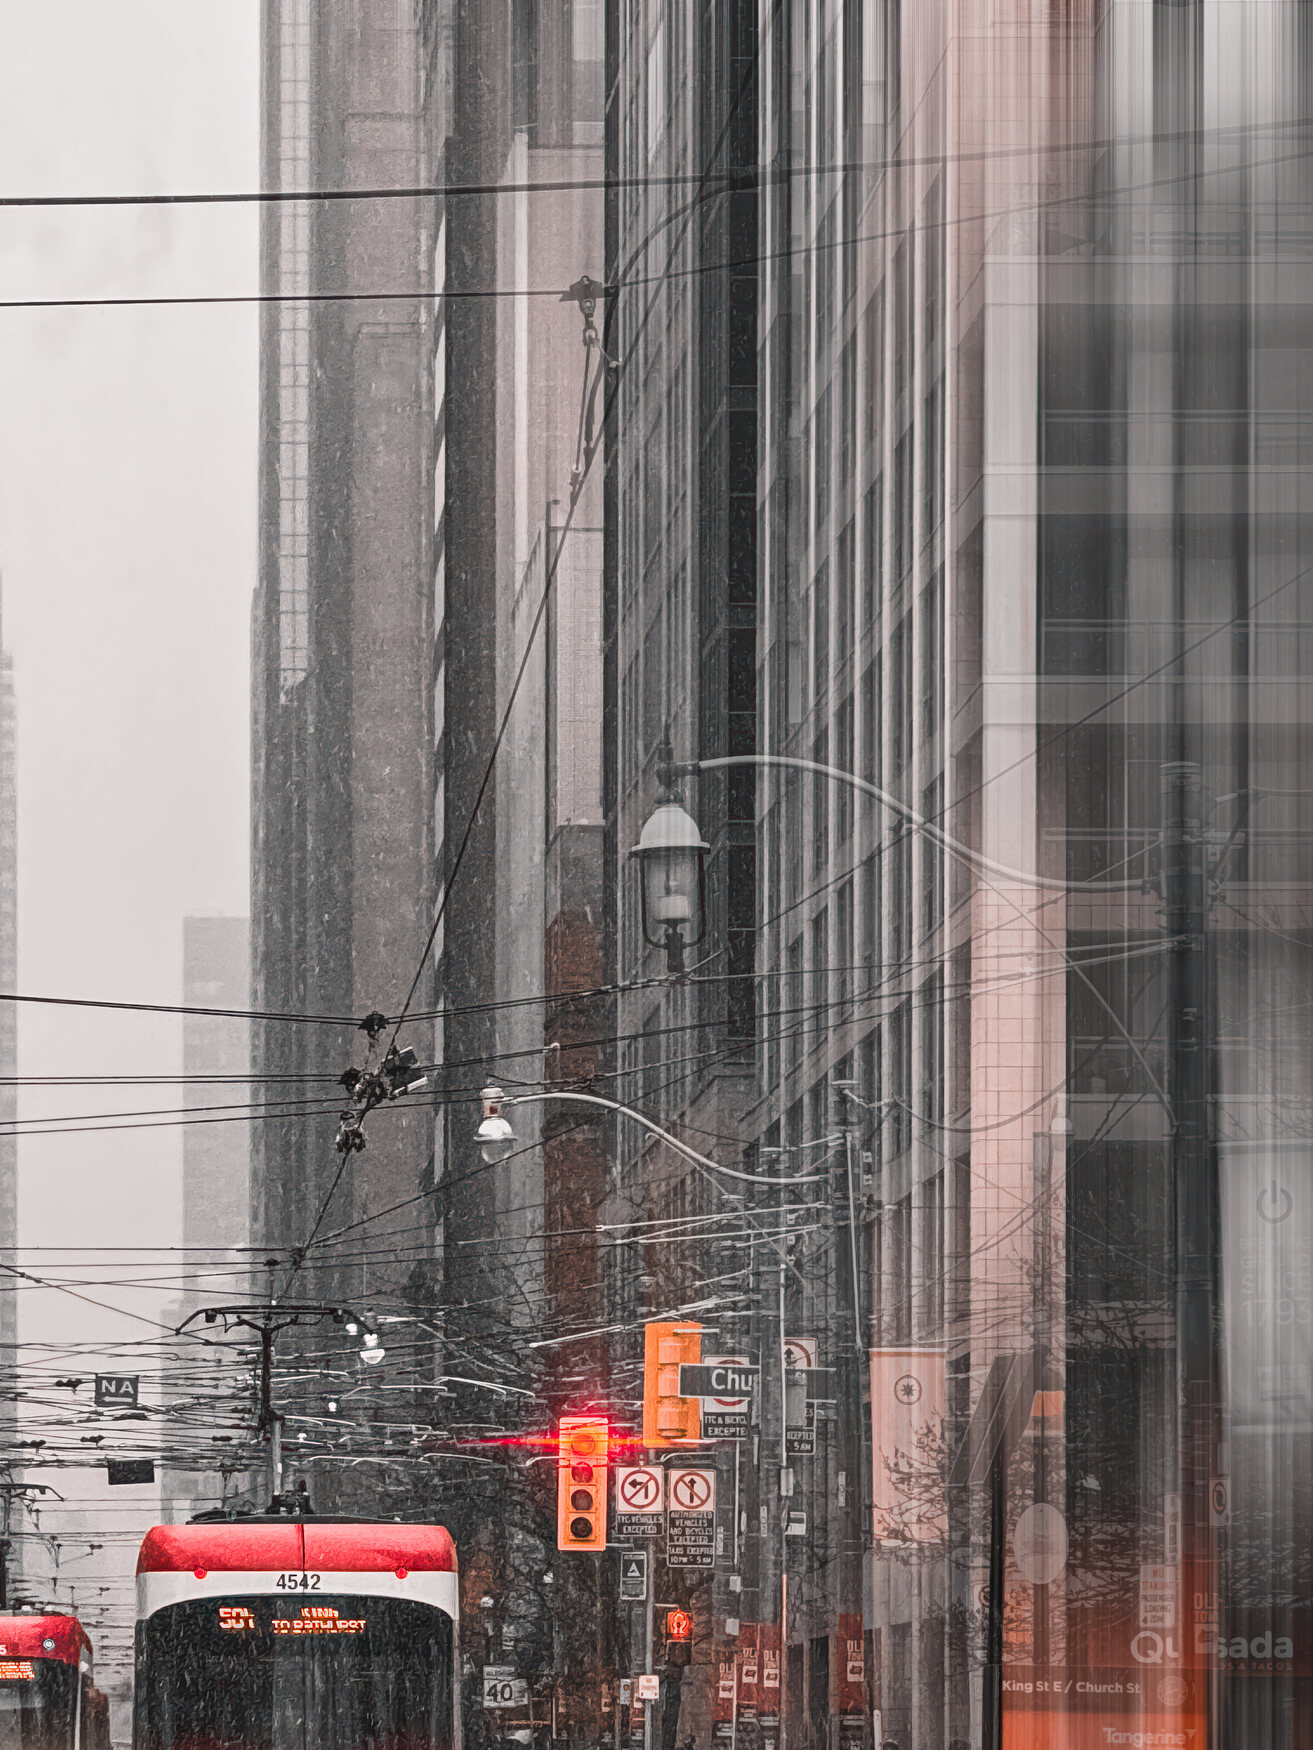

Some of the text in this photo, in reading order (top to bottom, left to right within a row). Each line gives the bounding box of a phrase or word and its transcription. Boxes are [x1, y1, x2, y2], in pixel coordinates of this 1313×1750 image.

[101, 1379, 135, 1394] NA
[707, 1427, 747, 1436] EXCEPTE
[276, 1573, 321, 1590] 4542
[487, 1683, 513, 1702] 40
[1002, 1680, 1033, 1694] King
[1035, 1680, 1050, 1692] St
[1053, 1681, 1063, 1692] E
[1075, 1681, 1124, 1694] Church
[1126, 1682, 1142, 1694] St
[1102, 1727, 1186, 1748] Tangerine
